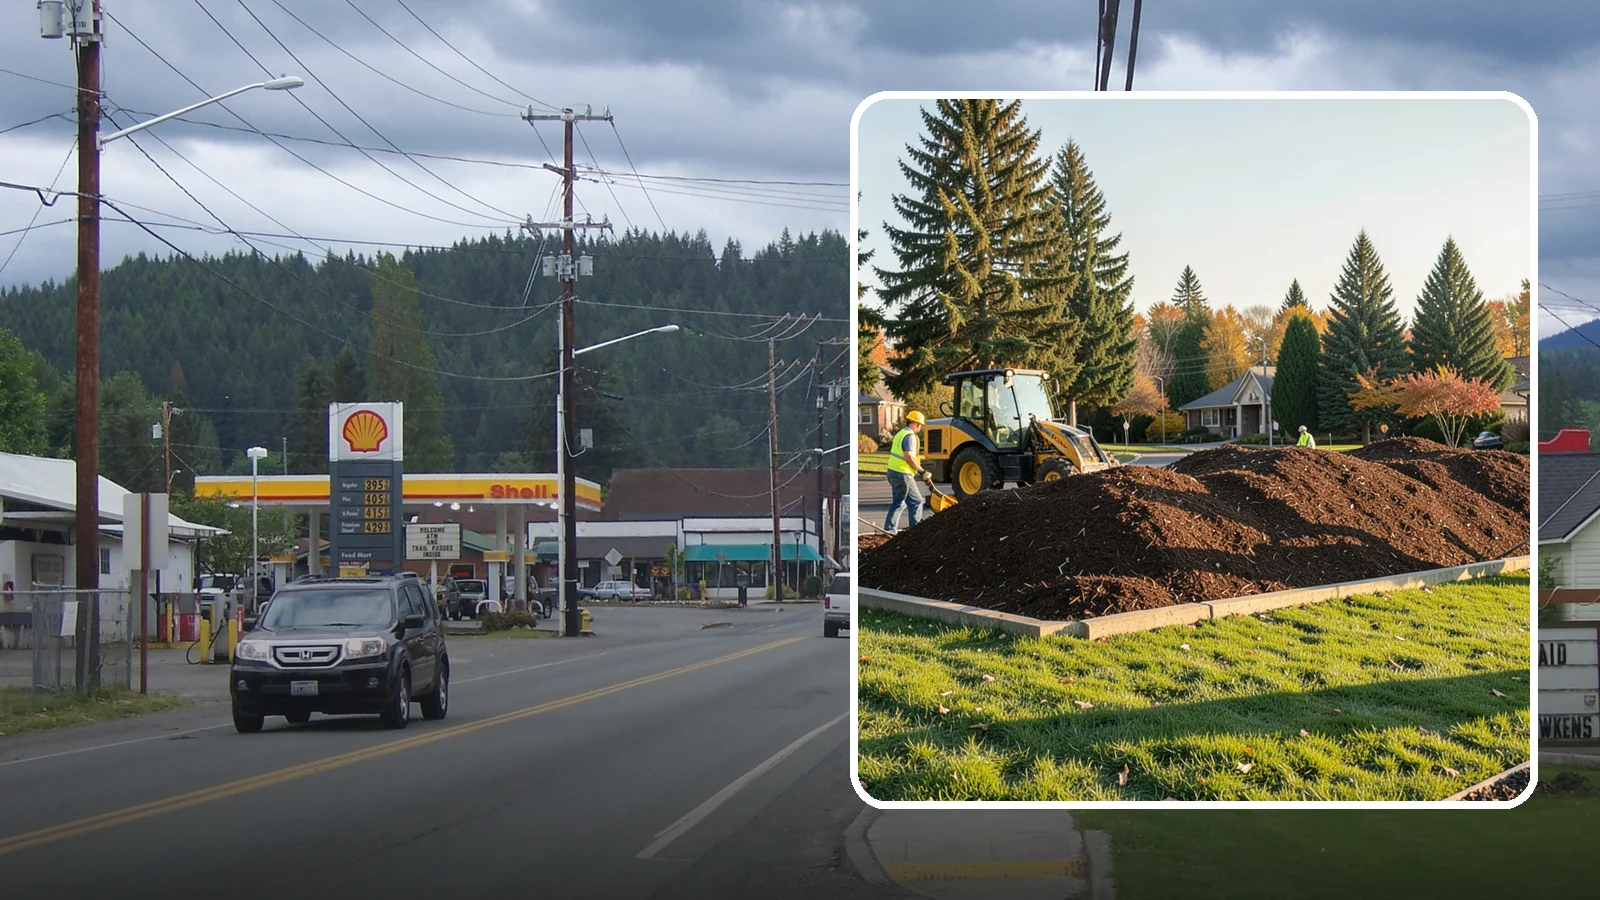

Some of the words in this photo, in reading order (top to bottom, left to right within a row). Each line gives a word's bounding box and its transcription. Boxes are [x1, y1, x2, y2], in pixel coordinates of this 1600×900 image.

[366, 480, 384, 490] 395
[490, 484, 547, 499] Shell
[366, 494, 384, 504] 405
[366, 508, 384, 518] 415
[366, 522, 384, 532] 429
